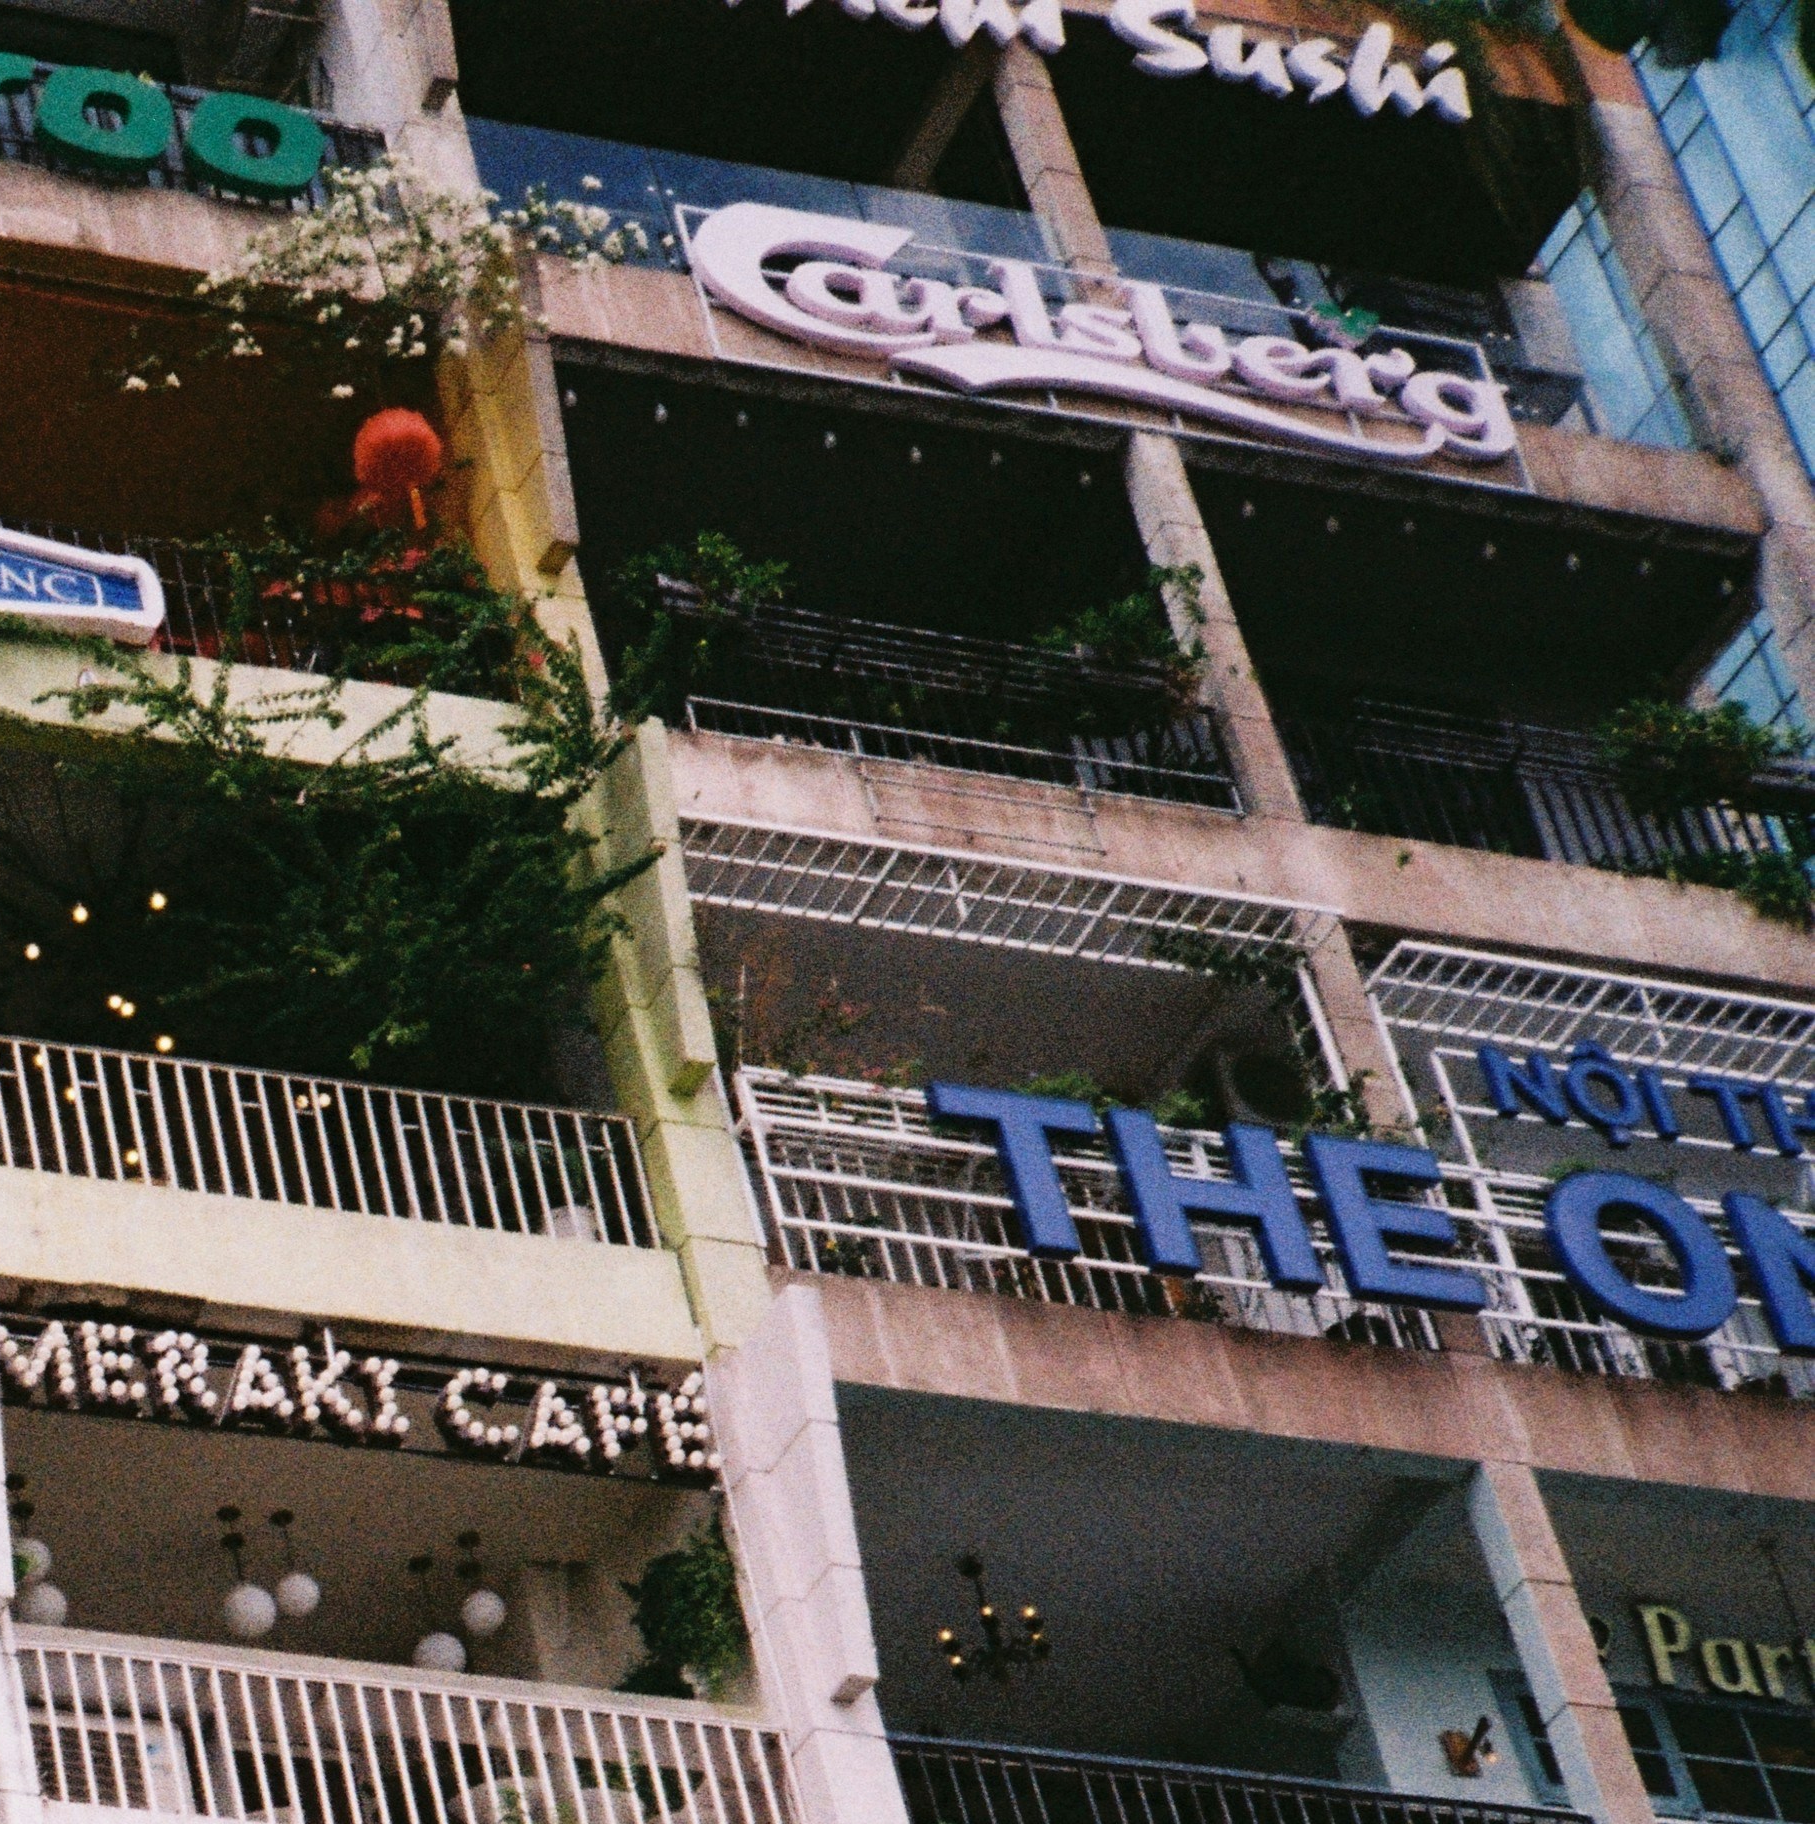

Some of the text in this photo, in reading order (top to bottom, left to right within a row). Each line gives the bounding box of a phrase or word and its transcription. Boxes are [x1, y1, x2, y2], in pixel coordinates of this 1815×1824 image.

[1109, 0, 1472, 123] Sushi
[691, 201, 1517, 466] Carlsberg
[1475, 1040, 1679, 1148] NỘI
[927, 1080, 1487, 1312] THE
[1636, 1604, 1815, 1702] Par
